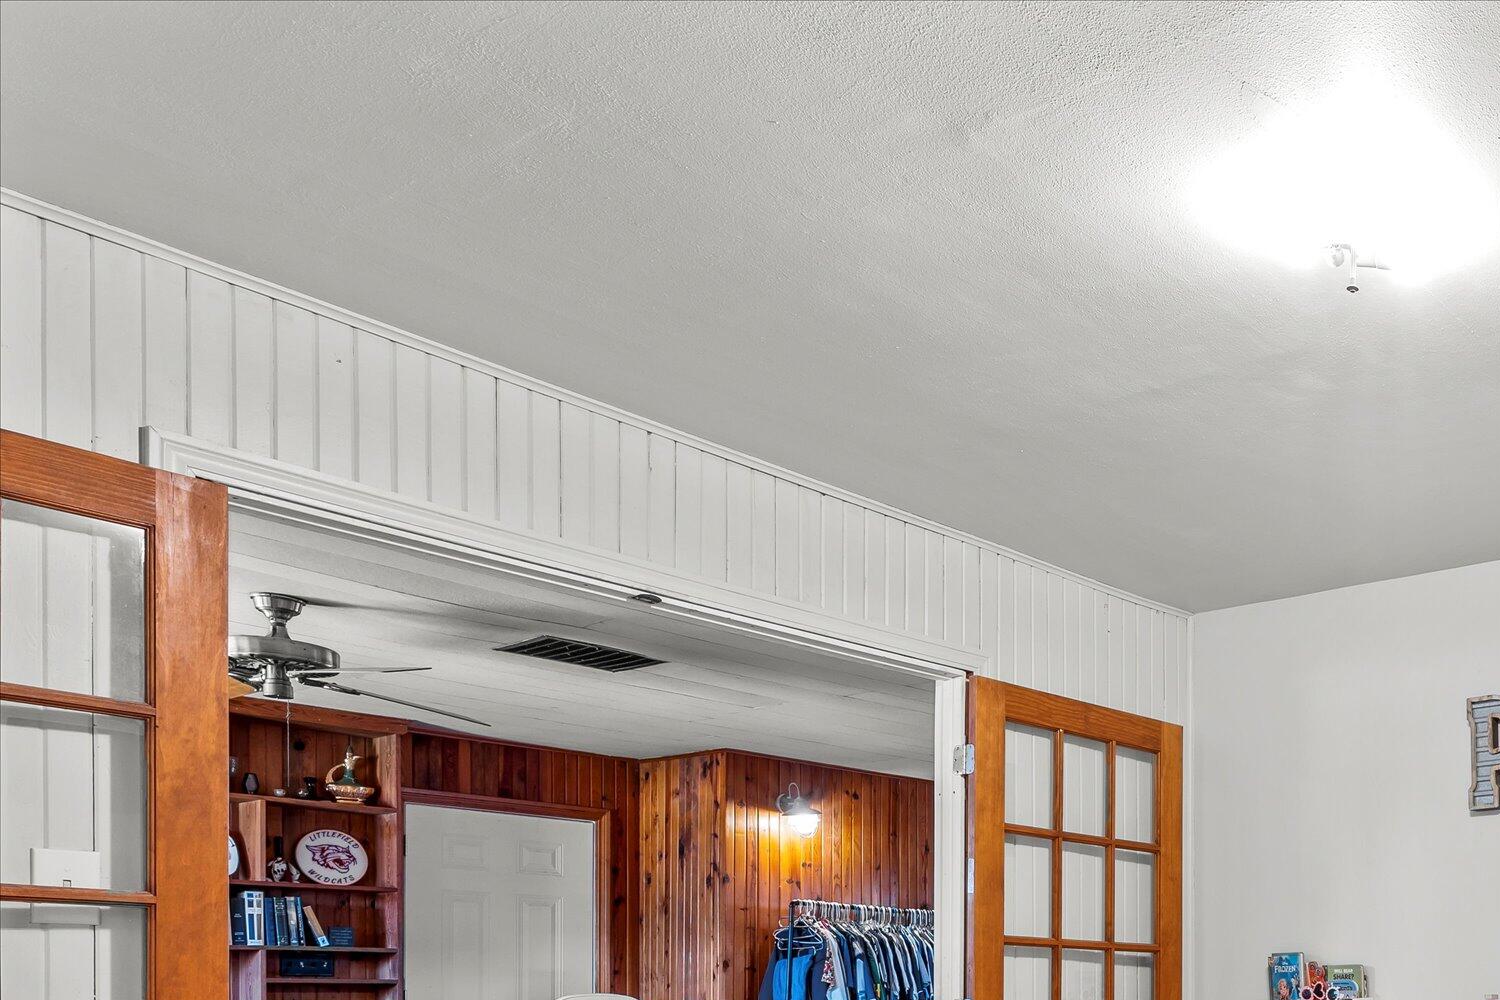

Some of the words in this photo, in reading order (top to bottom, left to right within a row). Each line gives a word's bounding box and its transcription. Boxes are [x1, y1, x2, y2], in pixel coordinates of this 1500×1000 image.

[309, 831, 360, 849] LITTLEFIELD
[308, 868, 355, 884] WILDCATS
[1275, 965, 1296, 973] FROZEN
